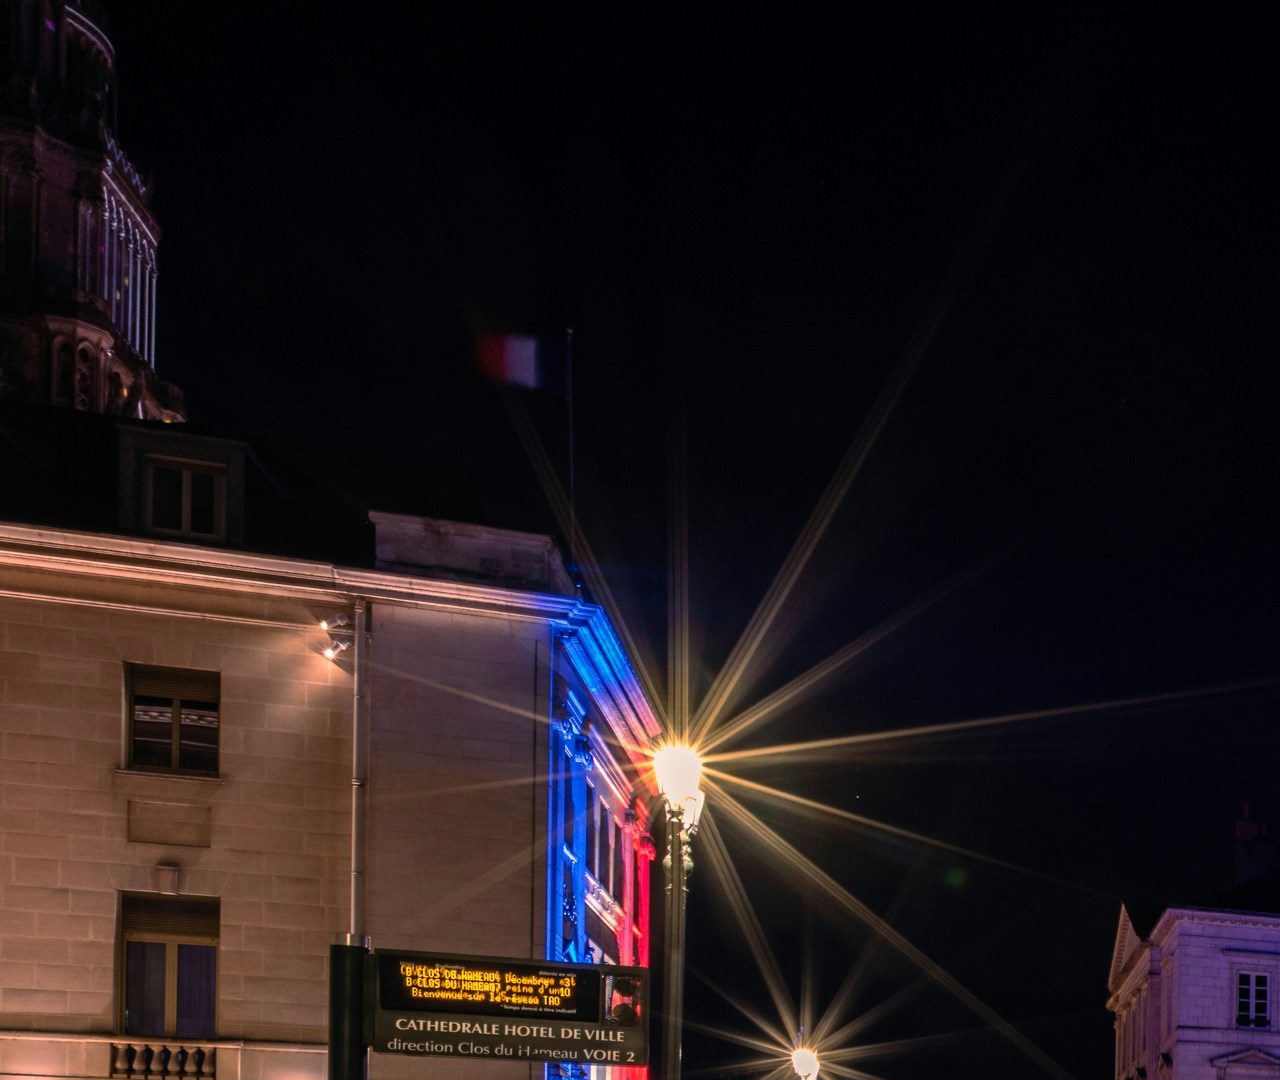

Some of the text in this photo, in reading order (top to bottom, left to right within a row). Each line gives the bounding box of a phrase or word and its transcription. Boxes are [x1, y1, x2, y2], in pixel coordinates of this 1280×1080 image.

[417, 978, 440, 988] CLOS
[445, 980, 457, 989] DU
[543, 995, 560, 1006] TAO
[395, 1018, 625, 1042] CATHEDRALE HOTEL DE VILLE
[387, 1038, 454, 1053] direction
[458, 1041, 490, 1056] Clos
[495, 1042, 513, 1056] du
[583, 1048, 620, 1062] VOIE
[626, 1051, 634, 1062] 2
